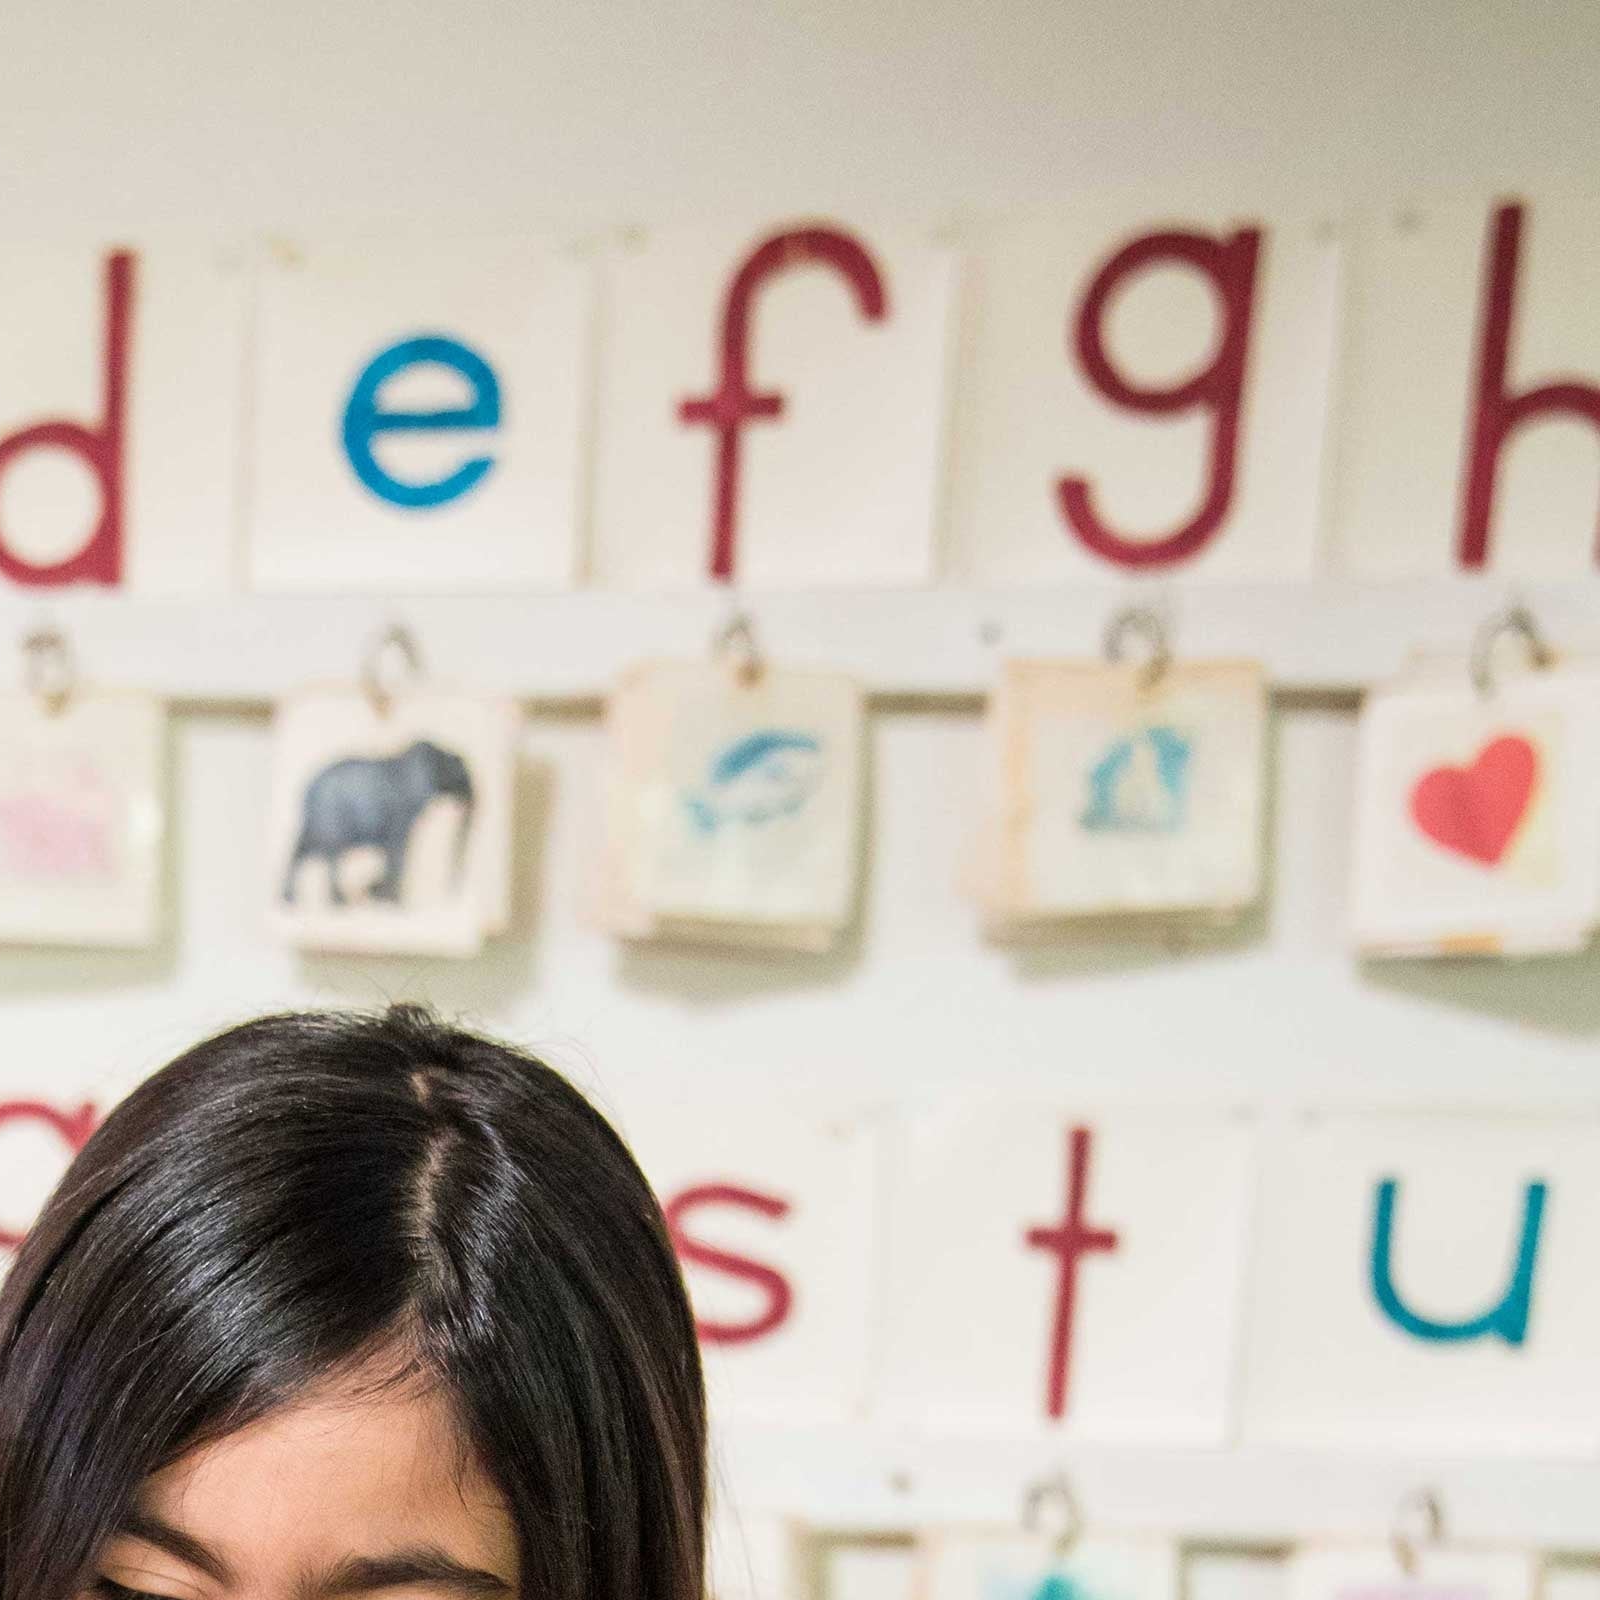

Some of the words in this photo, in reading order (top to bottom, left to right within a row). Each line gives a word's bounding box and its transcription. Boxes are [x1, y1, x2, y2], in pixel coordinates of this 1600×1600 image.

[339, 333, 503, 511] e
[675, 222, 890, 582] f
[1055, 223, 1263, 572] g
[1457, 202, 1599, 570] h
[664, 1182, 794, 1347] s
[1023, 1124, 1119, 1420] t
[1369, 1176, 1549, 1348] u
